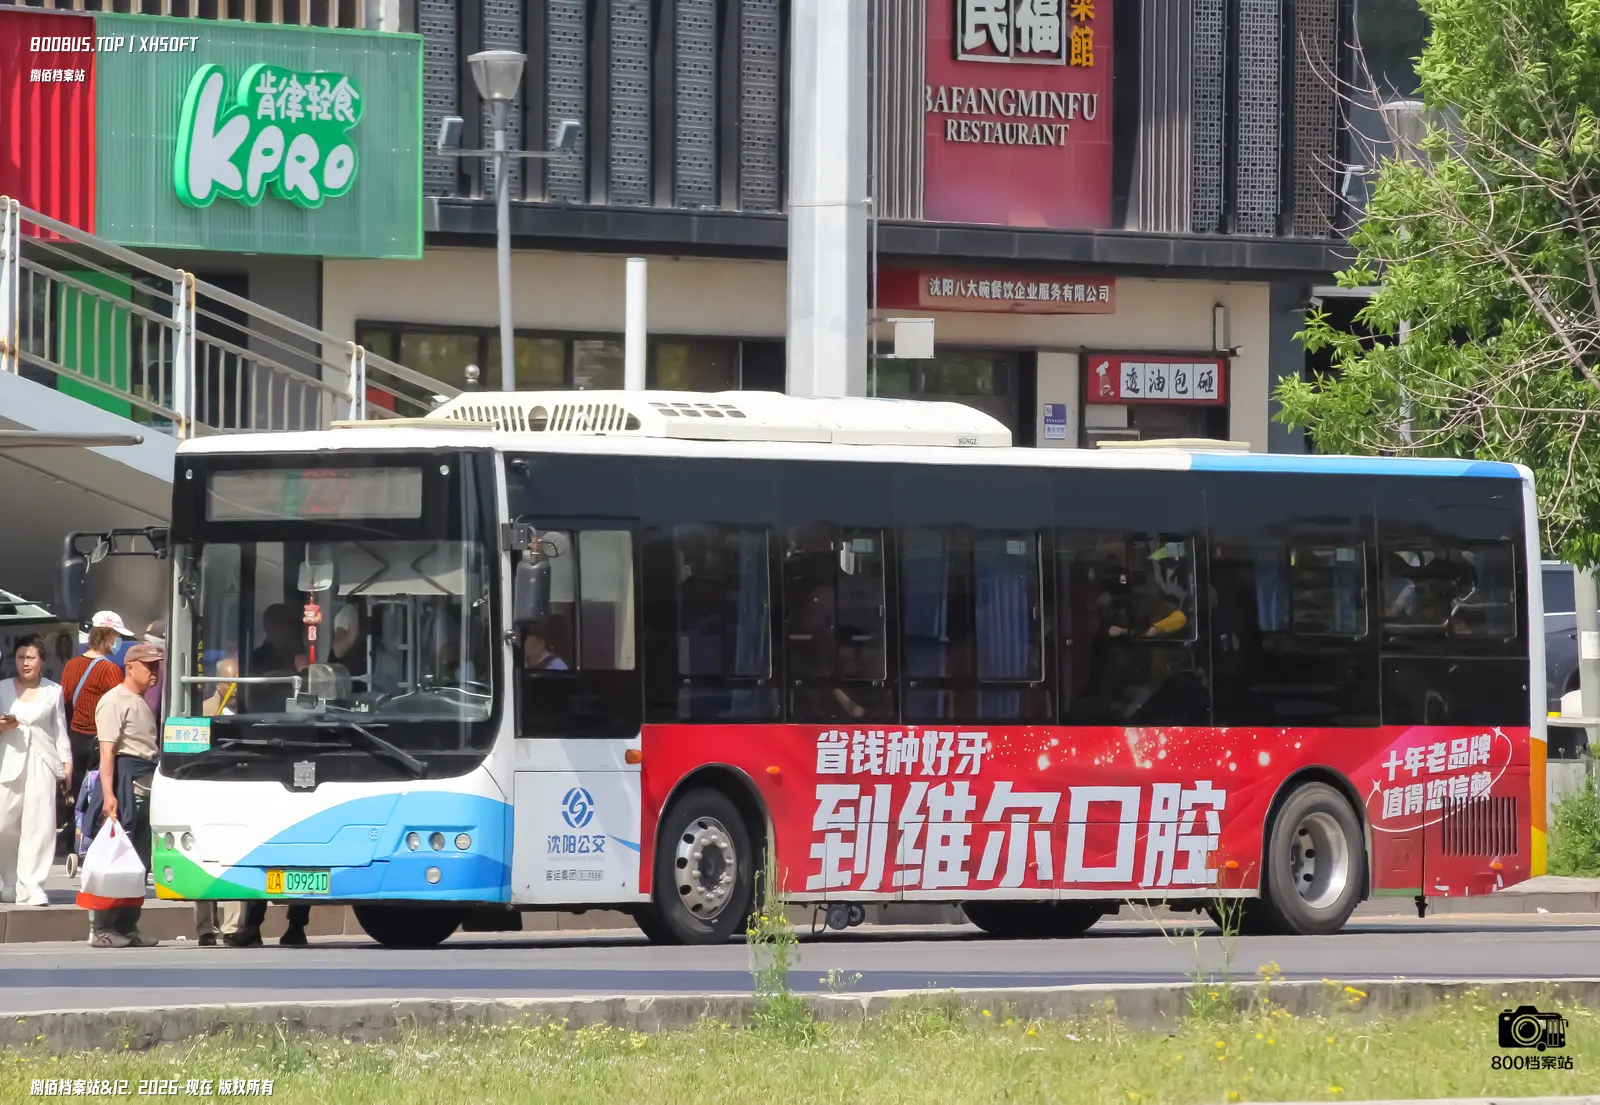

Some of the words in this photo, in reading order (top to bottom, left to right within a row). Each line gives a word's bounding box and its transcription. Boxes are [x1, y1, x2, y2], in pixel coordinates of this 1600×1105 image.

[963, 0, 1060, 53] 民福
[255, 70, 360, 123] 肯律轻食
[946, 118, 1069, 146] RESTAURANT
[929, 277, 1110, 303] 沈阳八大碗餐饮企业服务有限公司
[816, 730, 988, 776] 省钱种好牙
[1382, 734, 1491, 781] 十年老品牌
[1382, 771, 1492, 820] 值得您信赖
[547, 834, 606, 854] 沈阳公交
[806, 780, 1226, 890] 到维尔口腔
[287, 873, 328, 891] 09921D
[546, 869, 577, 881] 客运集团
